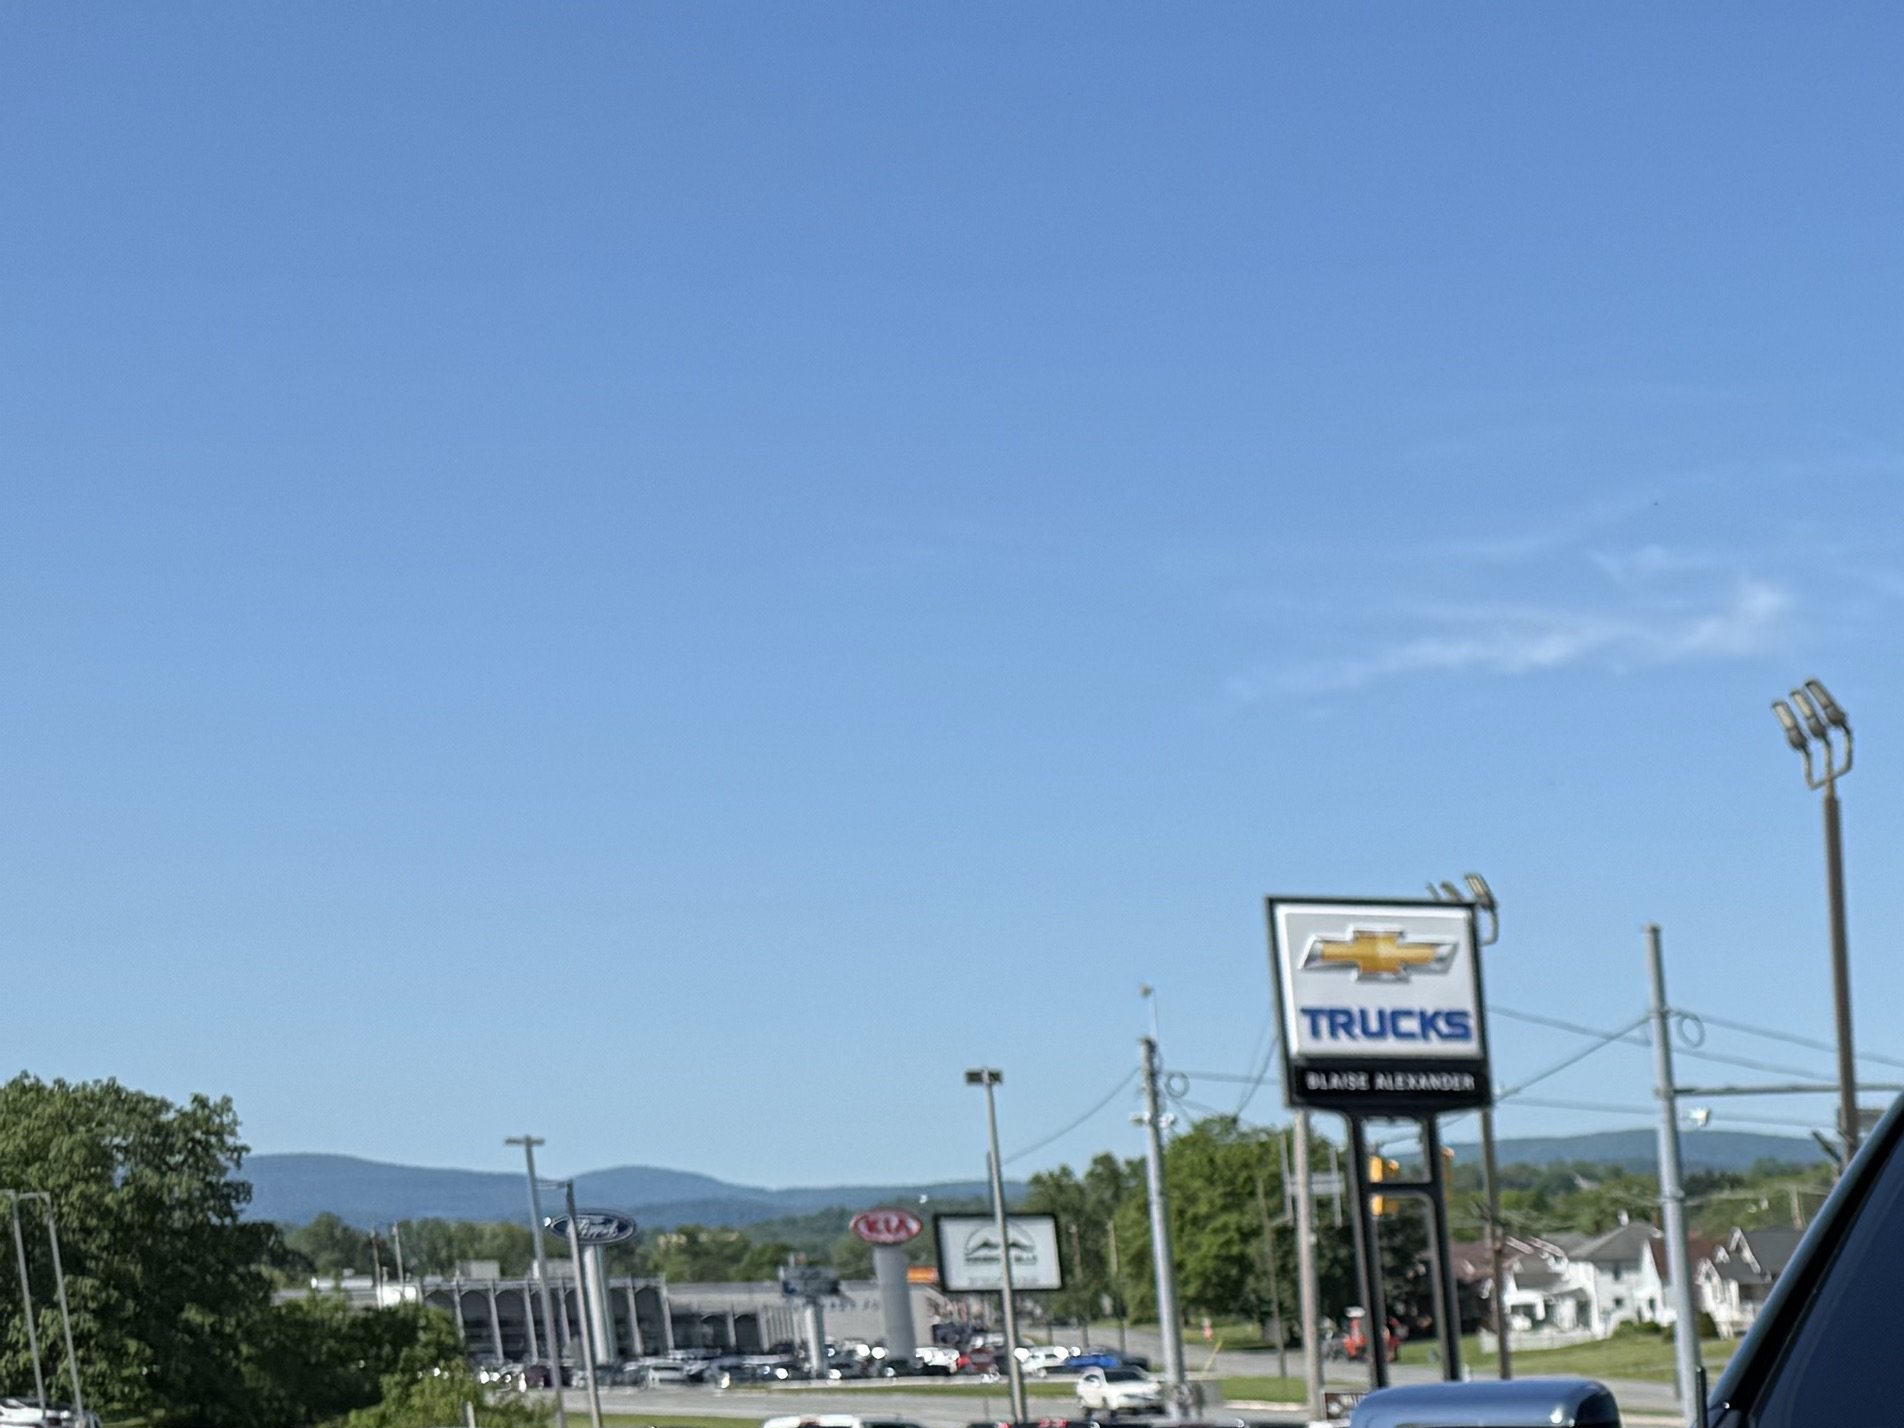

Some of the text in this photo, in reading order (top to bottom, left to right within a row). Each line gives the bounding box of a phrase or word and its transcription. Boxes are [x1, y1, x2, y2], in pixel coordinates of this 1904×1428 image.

[1301, 1008, 1473, 1042] TRUCKS
[1305, 1070, 1476, 1091] BLAISE ALEXANDER
